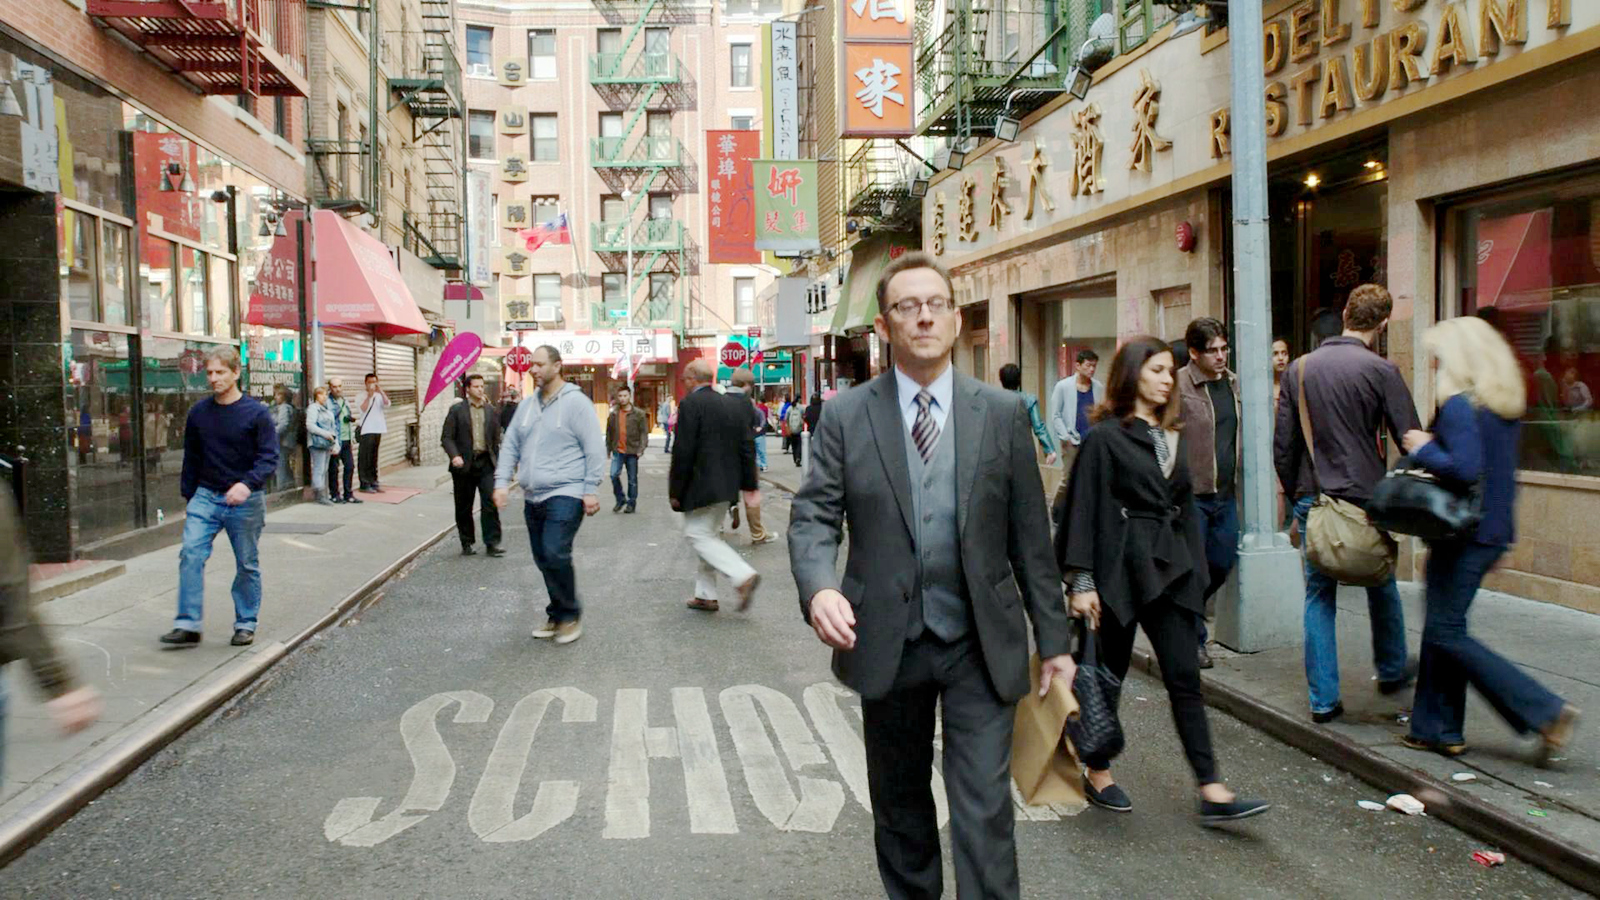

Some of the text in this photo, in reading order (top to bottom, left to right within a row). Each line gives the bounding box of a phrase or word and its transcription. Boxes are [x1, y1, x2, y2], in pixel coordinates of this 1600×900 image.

[1210, 0, 1572, 160] RSTAURAN
[508, 353, 533, 366] STOP
[722, 349, 746, 361] STOP
